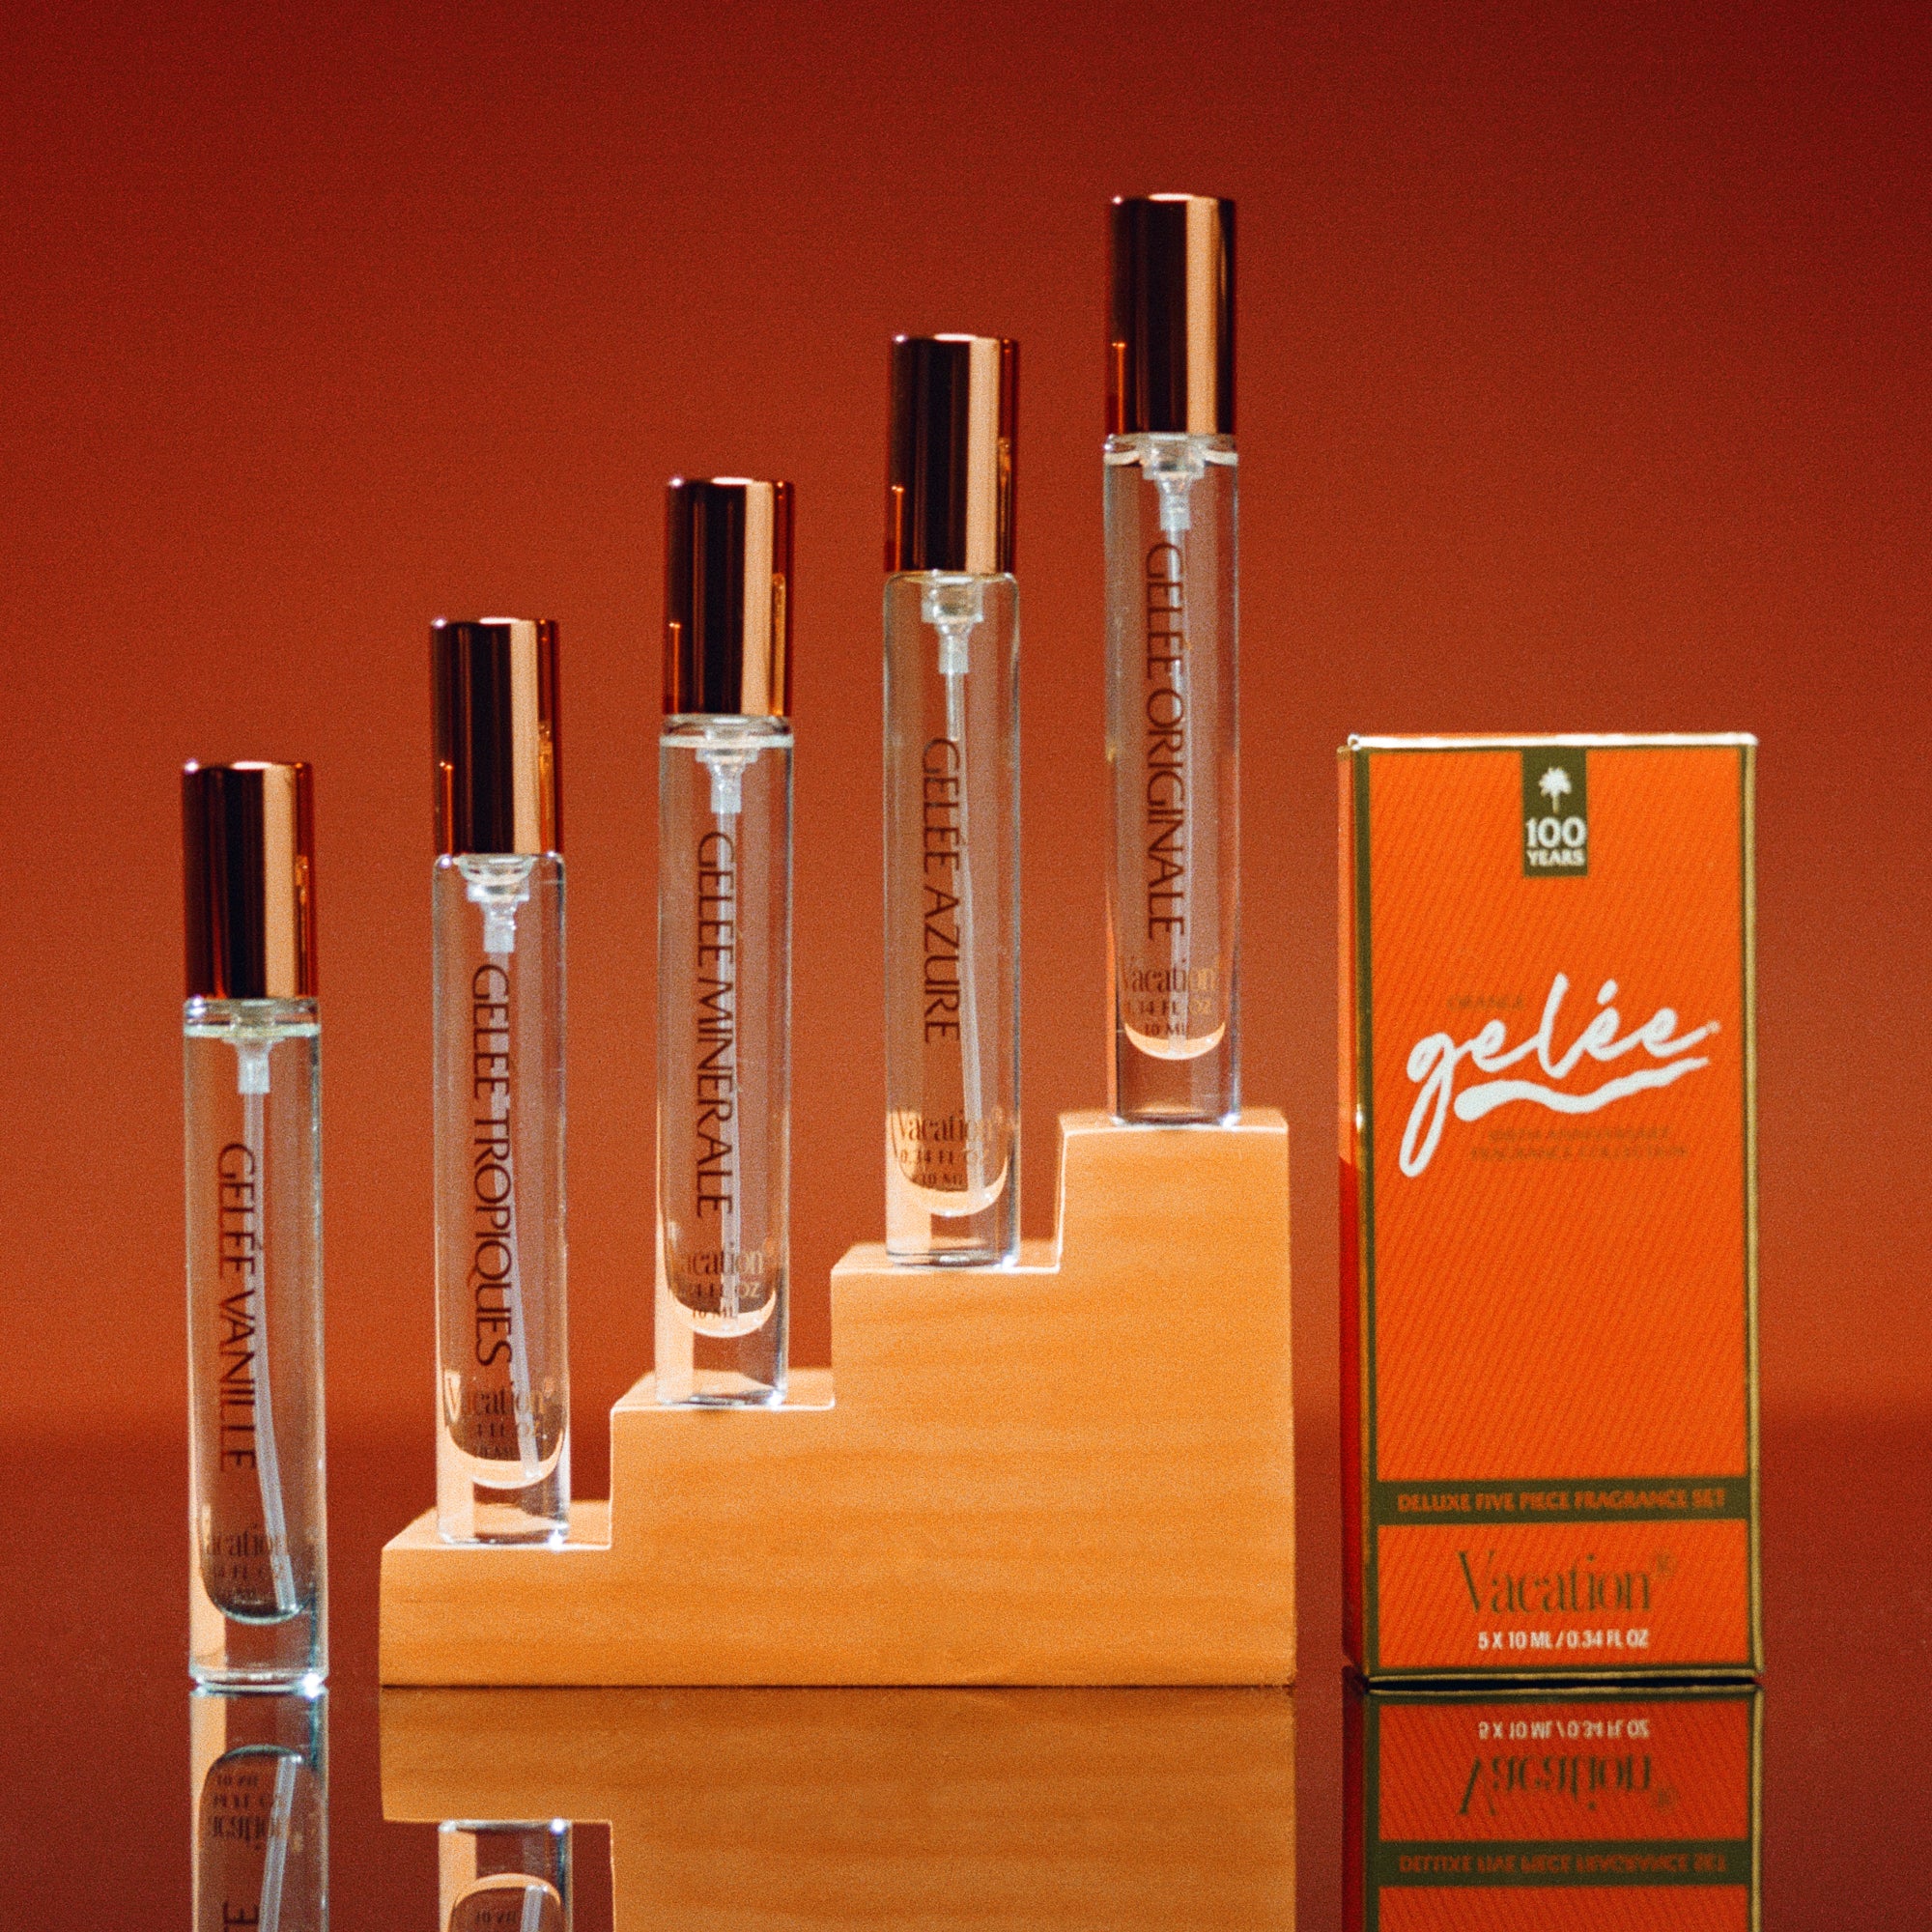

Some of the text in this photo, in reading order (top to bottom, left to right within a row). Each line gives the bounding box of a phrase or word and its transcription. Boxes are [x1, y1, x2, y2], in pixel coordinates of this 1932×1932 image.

[1146, 688, 1185, 941] ORIGINALE
[1526, 816, 1587, 848] 100
[1526, 849, 1585, 867] YEARS
[923, 885, 961, 1044] AZURE
[469, 1107, 513, 1366] TROPIQUES
[682, 1242, 763, 1274] cation
[218, 1288, 257, 1473] VANILLE
[1398, 1488, 1725, 1512] DELUXE FIVE PIECE FRAGRANCE SET
[1478, 1631, 1490, 1650] 5
[1492, 1631, 1504, 1650] X
[1508, 1631, 1527, 1650] 10
[1606, 1629, 1624, 1649] FL
[1627, 1628, 1649, 1648] OZ
